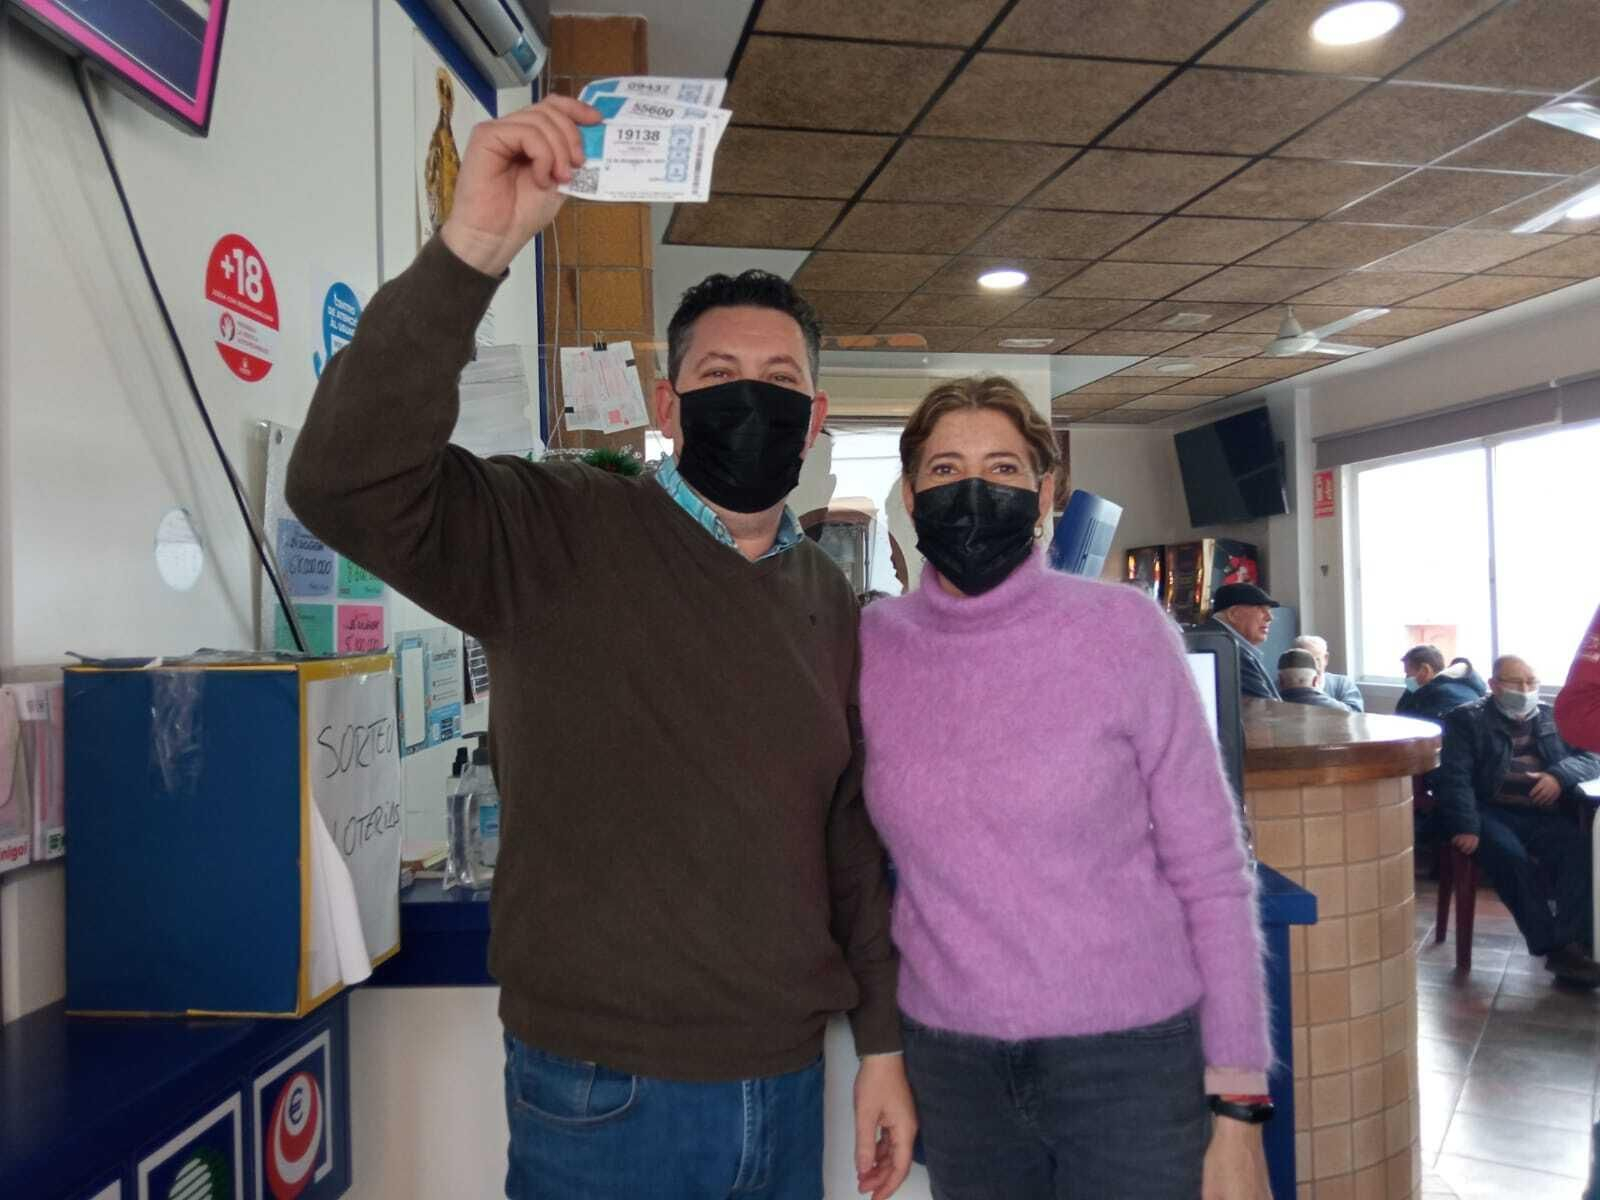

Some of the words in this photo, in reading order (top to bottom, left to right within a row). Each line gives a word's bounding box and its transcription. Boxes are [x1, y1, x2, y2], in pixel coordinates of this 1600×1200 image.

[633, 102, 675, 118] 55600
[616, 128, 661, 142] 19138
[220, 248, 264, 303] +18
